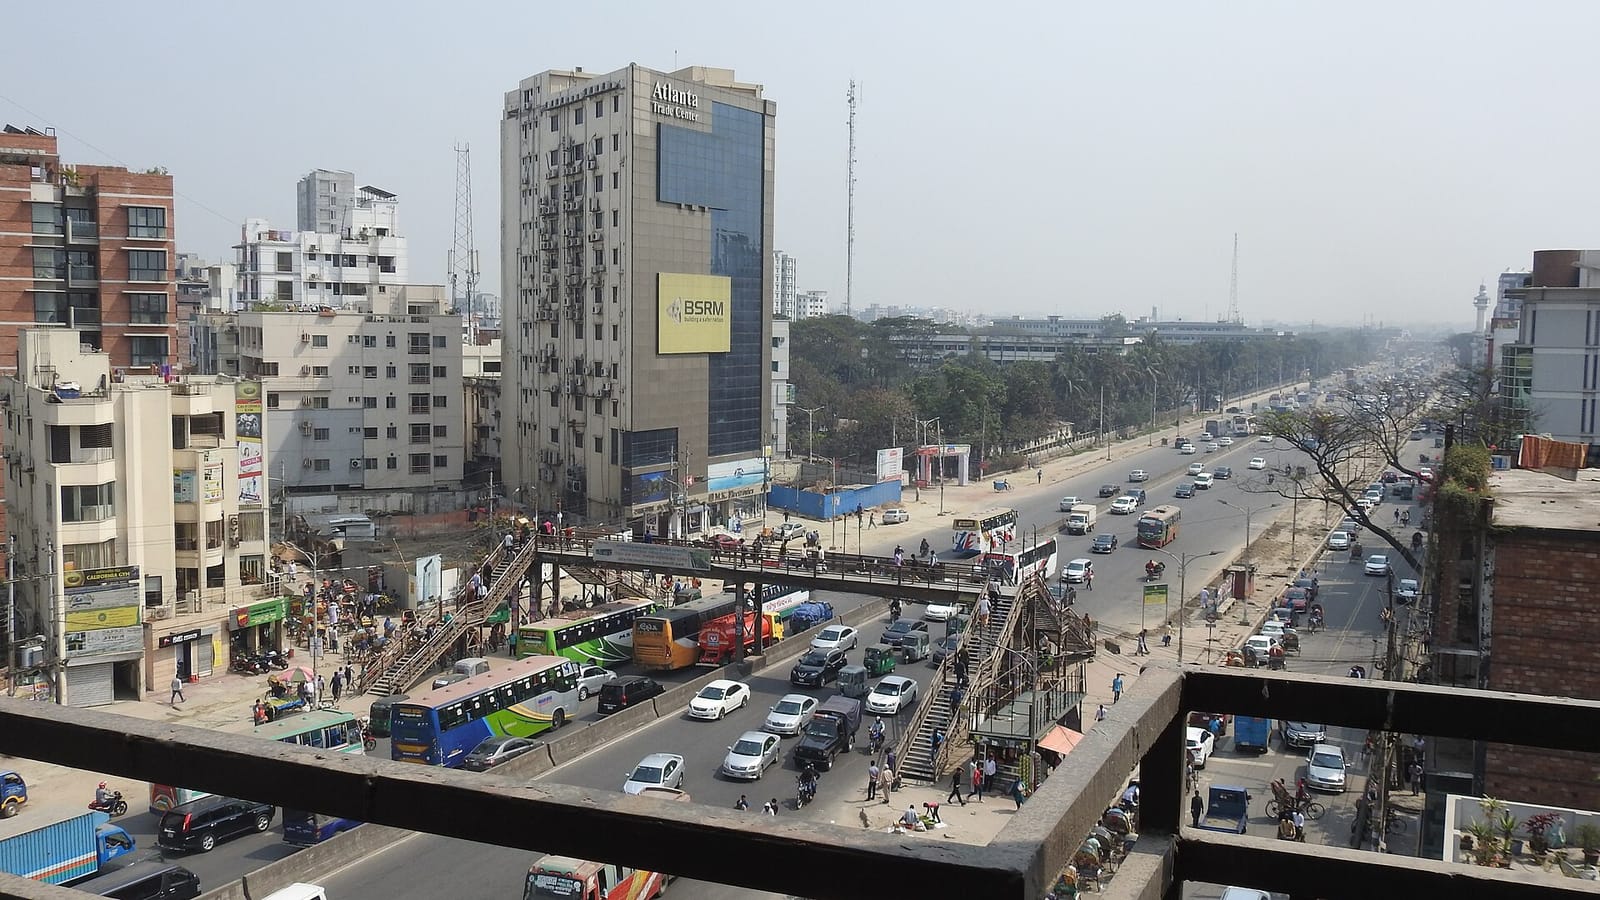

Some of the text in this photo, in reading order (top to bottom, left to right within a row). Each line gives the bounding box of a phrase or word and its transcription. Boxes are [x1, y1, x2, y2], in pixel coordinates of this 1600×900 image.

[652, 80, 698, 108] Atlanta
[652, 100, 699, 121] Trade Center
[684, 300, 724, 316] BSRM
[230, 517, 239, 549] GYM
[86, 572, 118, 581] CALIFORNIA
